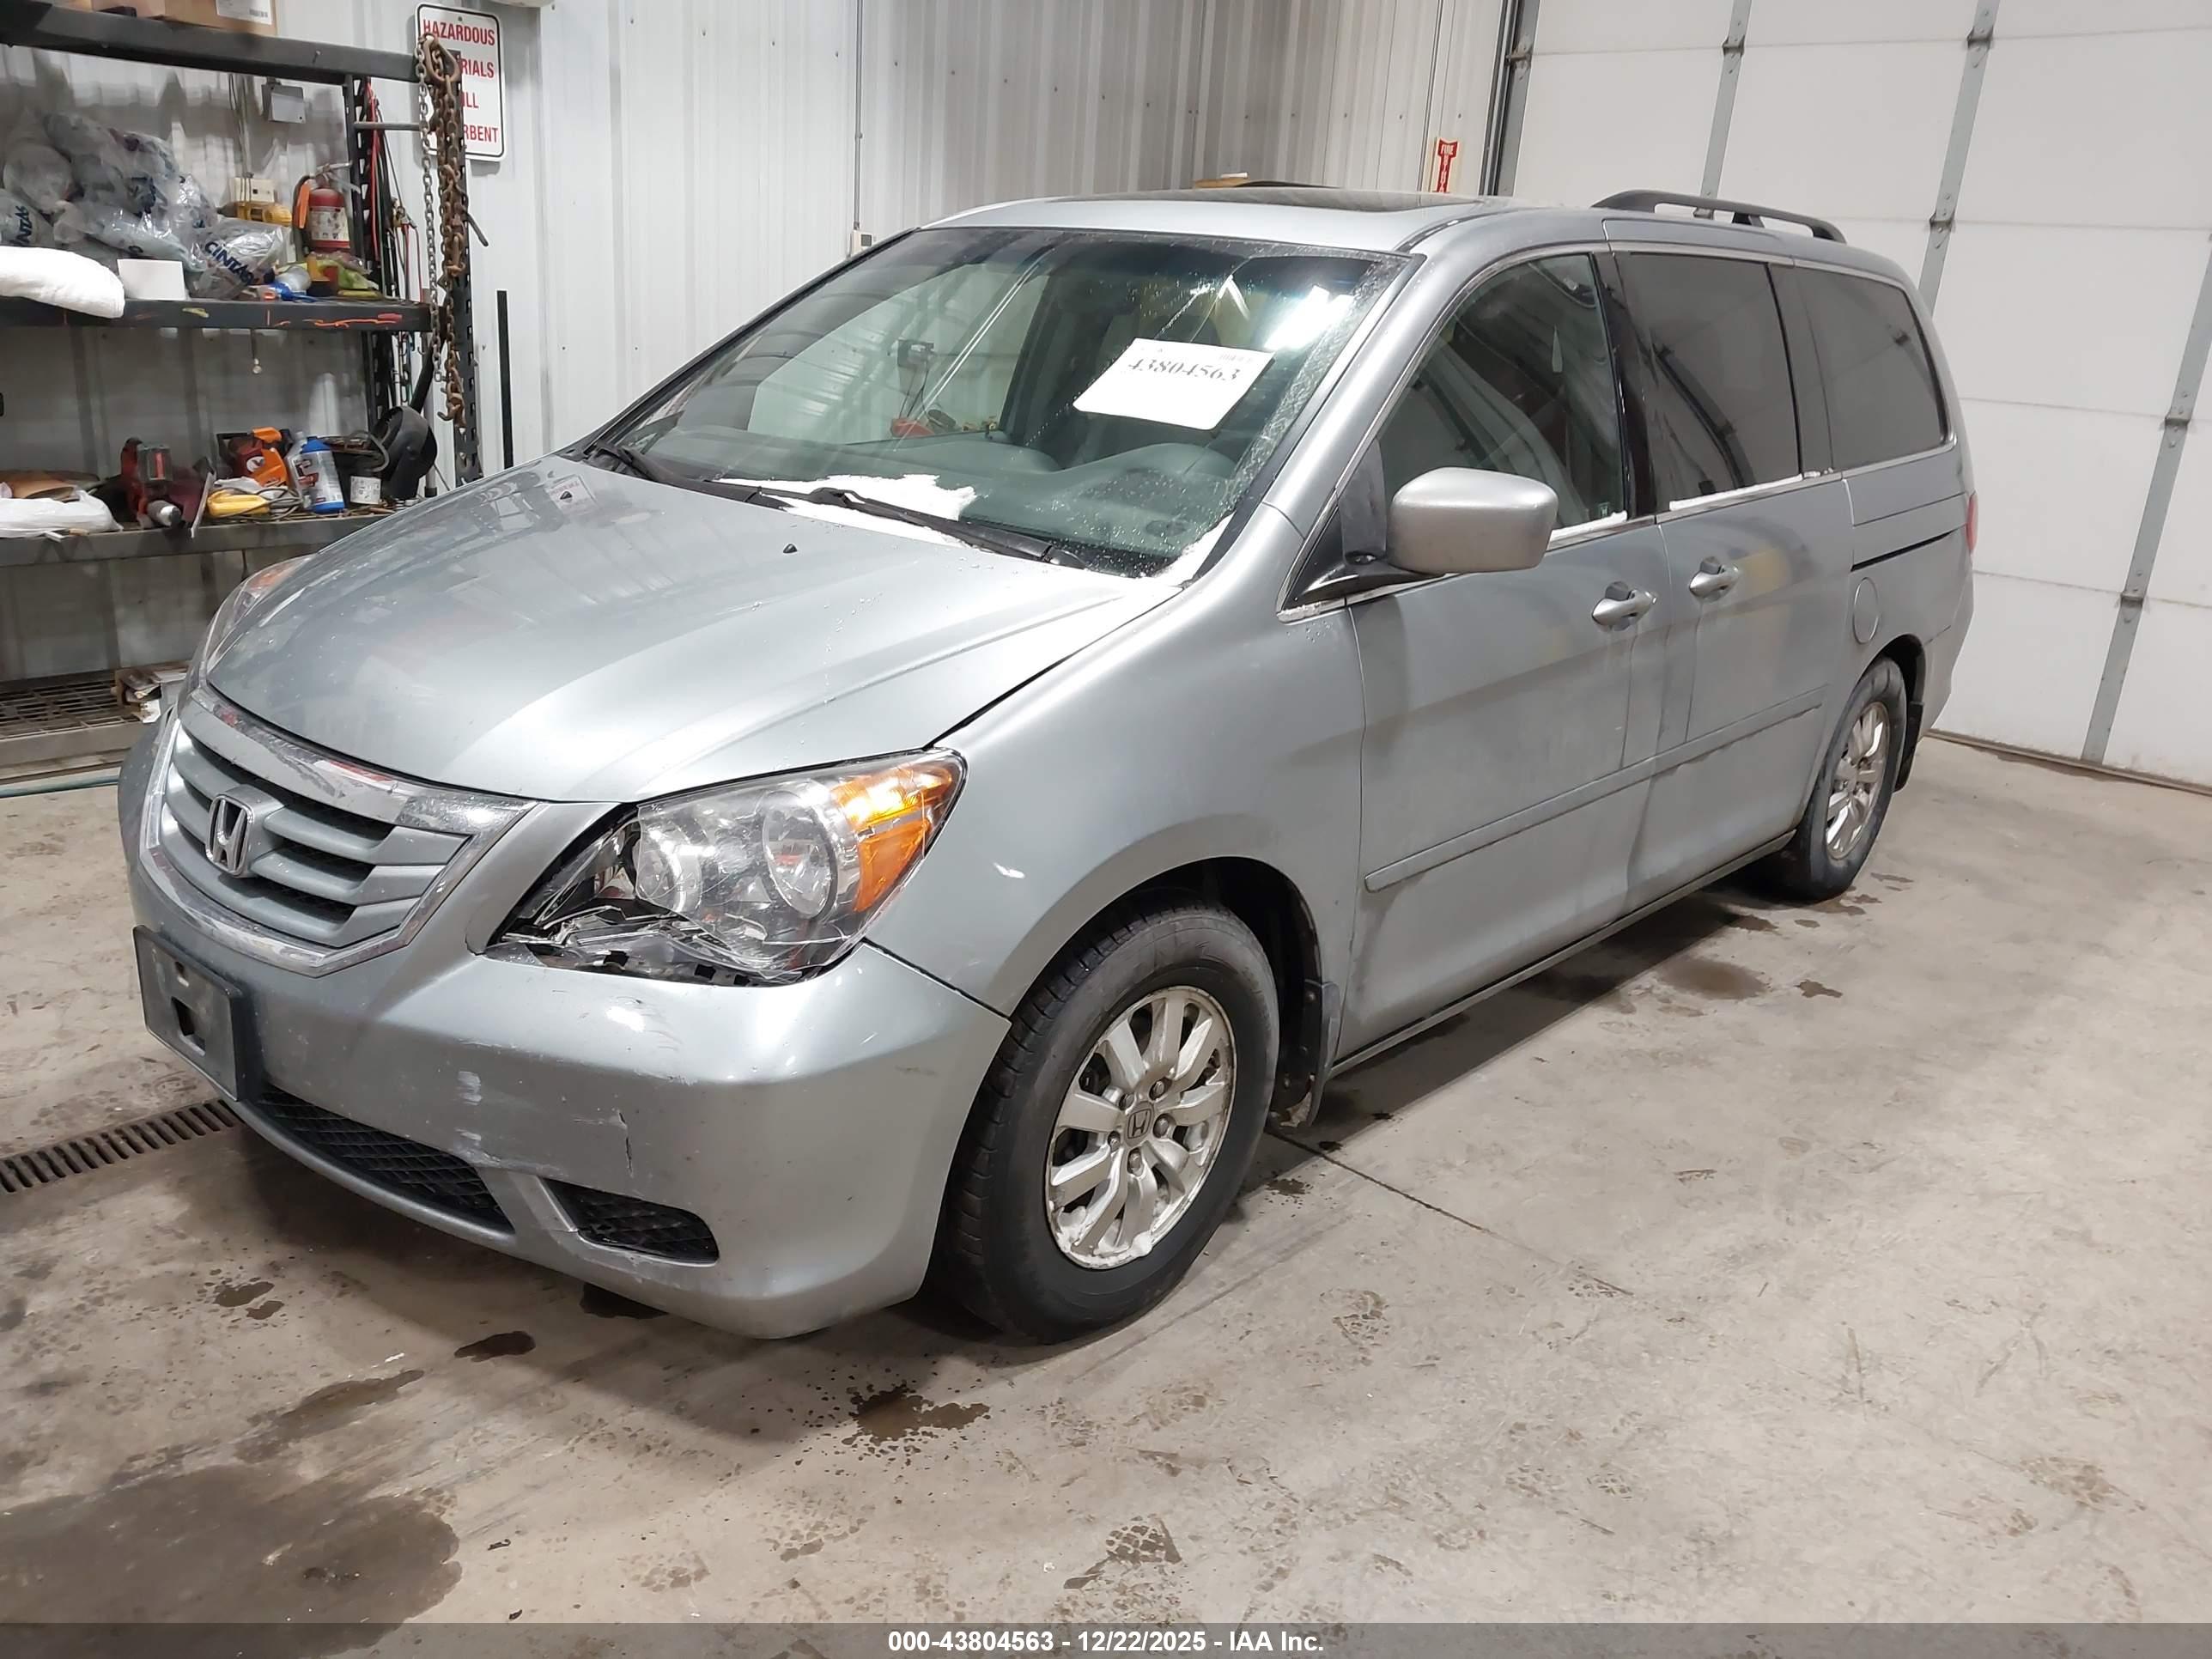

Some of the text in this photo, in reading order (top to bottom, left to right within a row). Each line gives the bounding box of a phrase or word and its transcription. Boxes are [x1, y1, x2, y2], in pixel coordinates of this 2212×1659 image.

[422, 19, 495, 46] HAZARDOUS
[459, 58, 495, 78] RIALS
[463, 124, 499, 143] RBENT
[205, 241, 254, 287] CINTAS
[1128, 358, 1241, 381] 43804563
